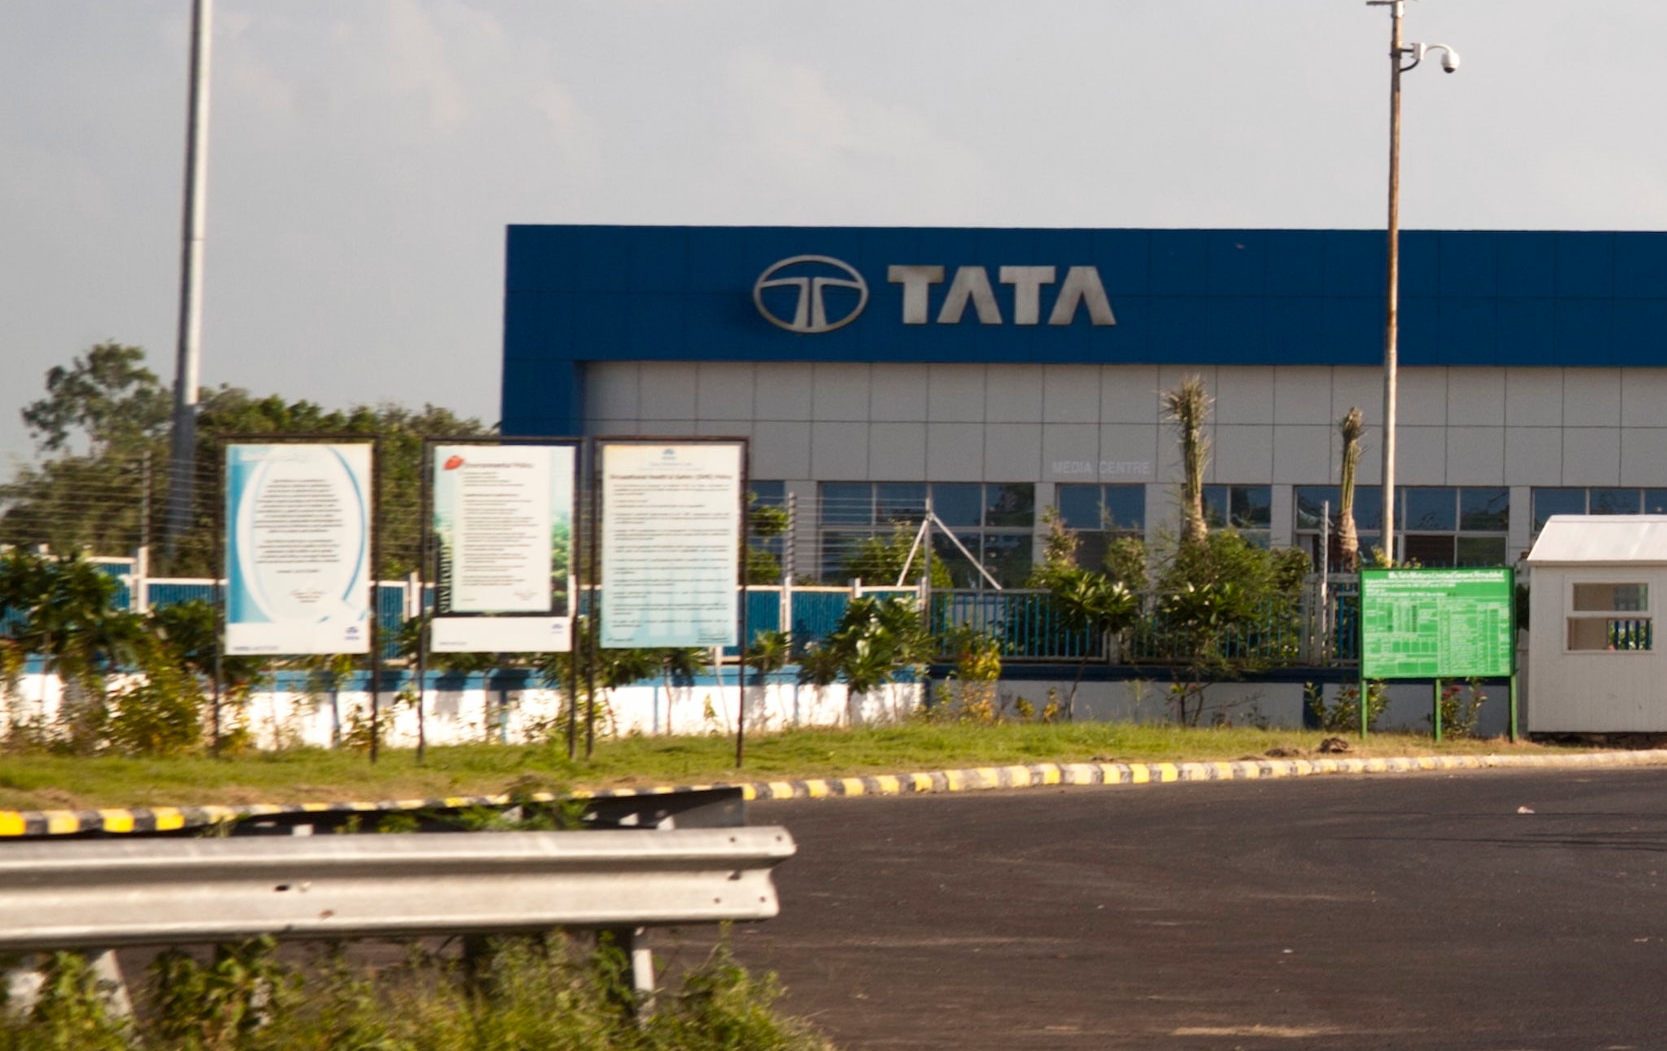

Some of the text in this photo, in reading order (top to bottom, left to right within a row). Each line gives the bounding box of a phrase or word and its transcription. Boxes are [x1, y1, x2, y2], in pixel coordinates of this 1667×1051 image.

[888, 265, 1116, 325] TATA
[1052, 460, 1151, 475] MEDIA CENTRE
